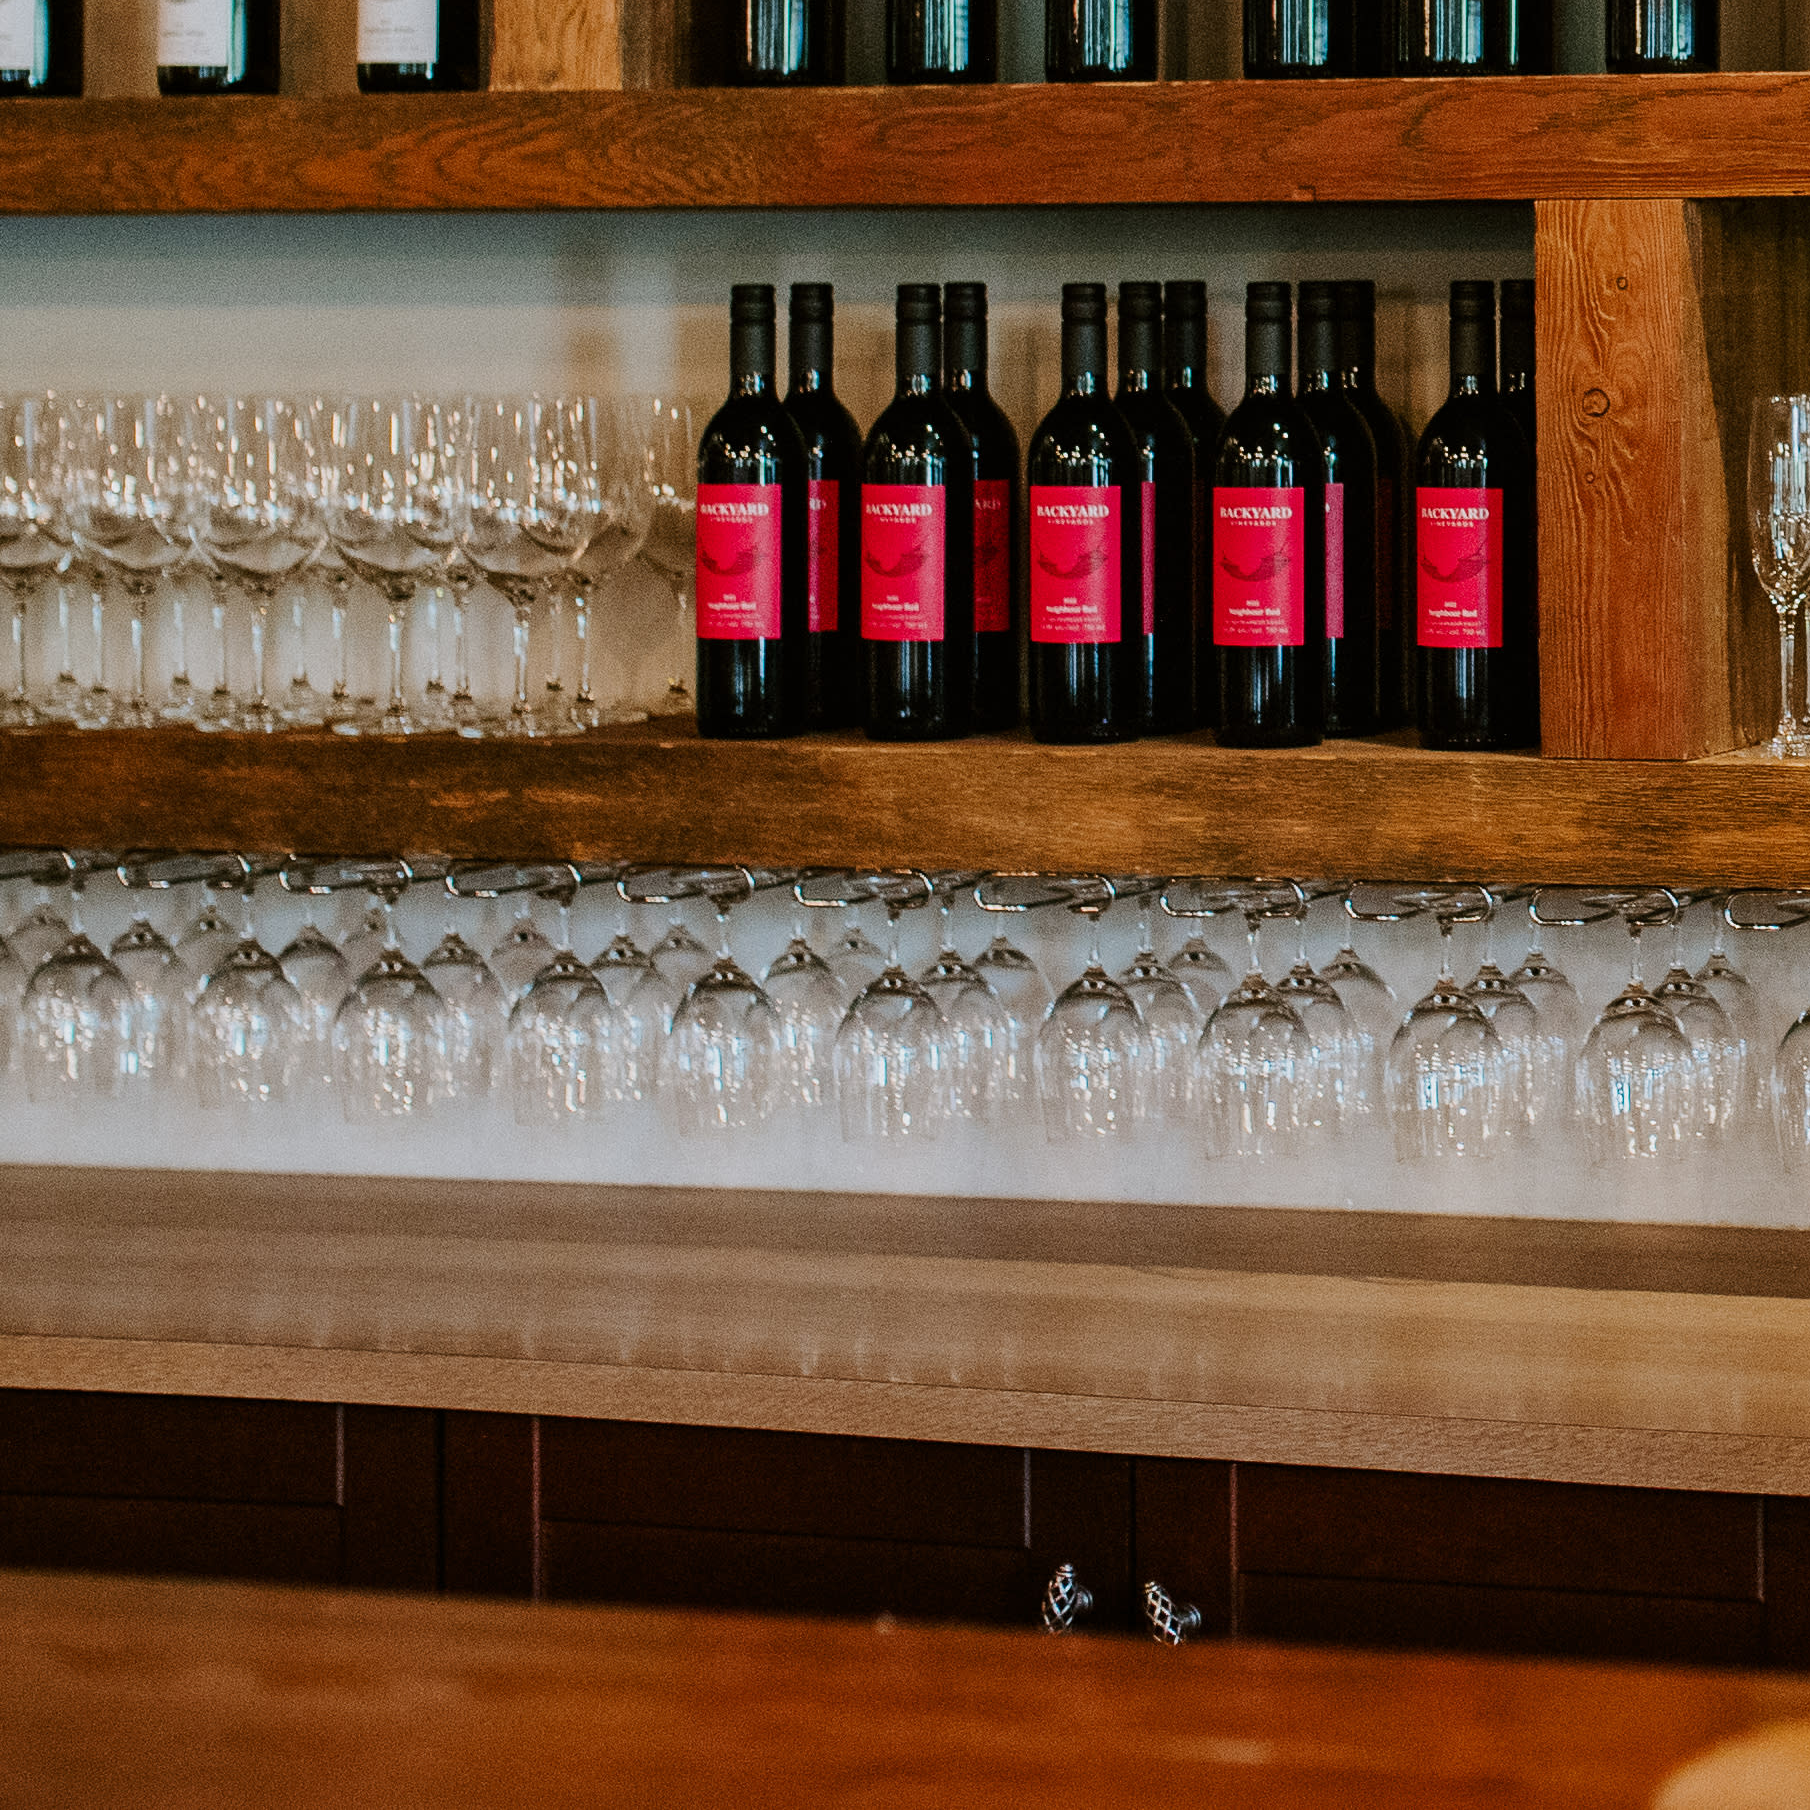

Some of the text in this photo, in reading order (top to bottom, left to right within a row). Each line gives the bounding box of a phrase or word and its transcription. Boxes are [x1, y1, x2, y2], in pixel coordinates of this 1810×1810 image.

[1037, 505, 1111, 519] BACKYARD
[1220, 506, 1294, 520] BACKYARD
[1421, 506, 1490, 520] BACKYARD
